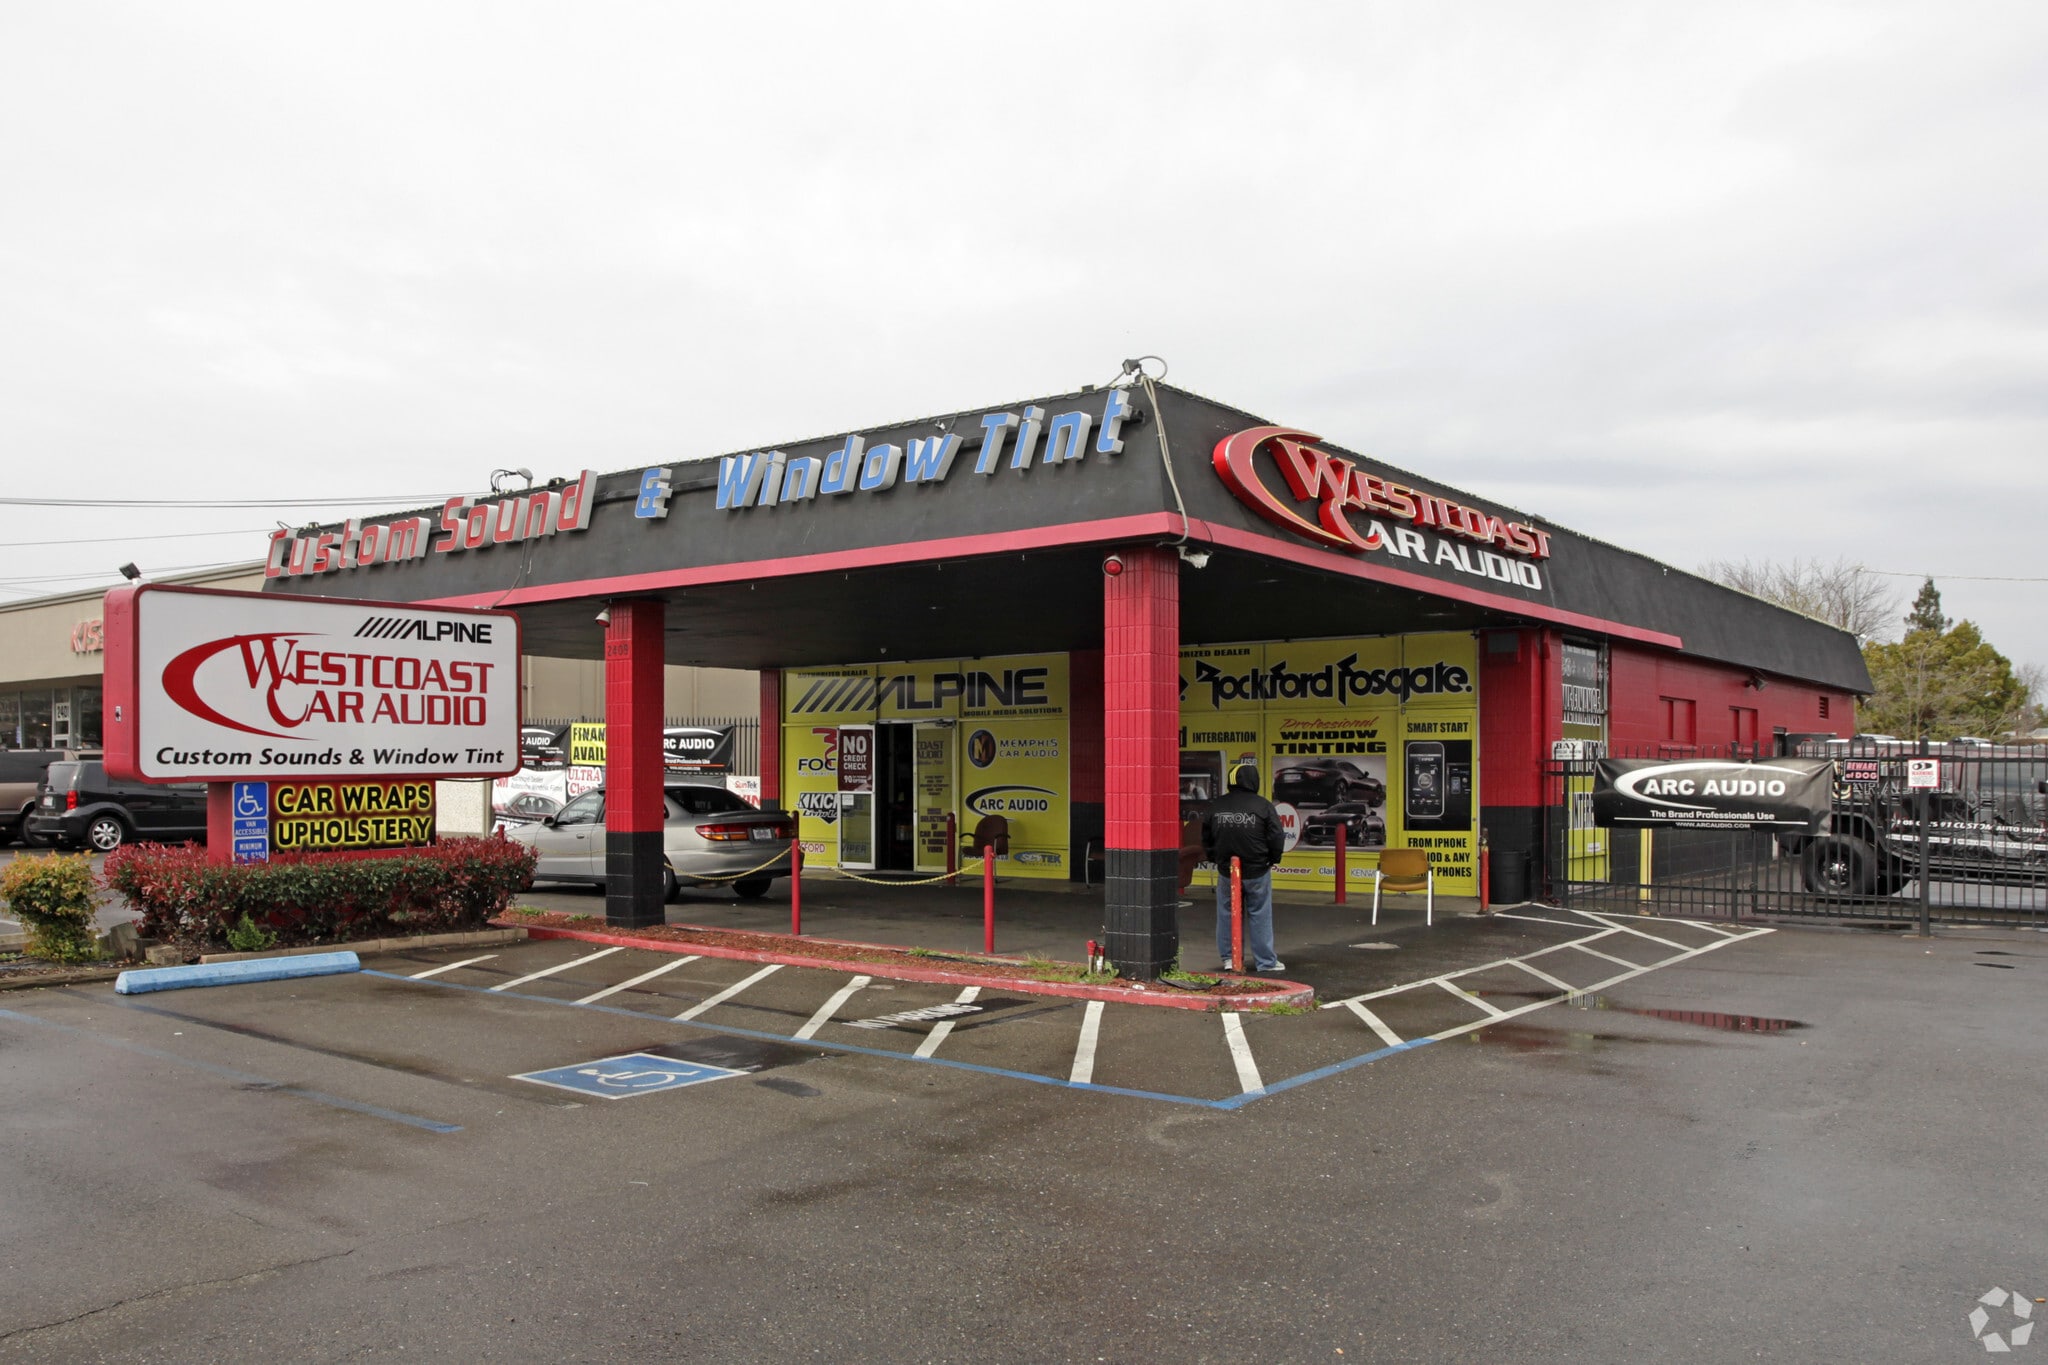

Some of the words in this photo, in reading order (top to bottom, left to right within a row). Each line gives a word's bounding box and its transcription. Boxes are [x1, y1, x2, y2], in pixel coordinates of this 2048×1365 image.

[264, 517, 431, 580] Custom
[435, 469, 598, 553] Sound
[634, 466, 673, 519] &
[716, 434, 964, 511] Window
[974, 388, 1133, 476] Tint
[1266, 437, 1551, 562] WESTCOAST
[1320, 498, 1430, 565] CAR
[1433, 542, 1543, 592] AUDIO
[71, 620, 104, 653] KIS
[400, 618, 492, 645] ALPINE
[1178, 650, 1211, 659] ORIZED
[1214, 648, 1250, 657] DEALER
[234, 634, 495, 694] WESTCOAST
[842, 669, 868, 679] DEALER
[866, 667, 1048, 711] ALPINE
[1196, 659, 1334, 710] Rockford
[266, 684, 365, 728] CAR
[371, 692, 487, 727] AUDIO
[963, 709, 991, 718] MOBILE
[993, 708, 1016, 717] MEDIA
[1018, 706, 1063, 716] SOLUTIONS
[1280, 716, 1380, 731] Professional
[1407, 722, 1438, 733] SMART
[1440, 721, 1469, 733] START
[573, 727, 606, 742] FINAN
[1192, 731, 1257, 743] INTERGRATION
[1280, 729, 1378, 741] WINDOW
[526, 736, 551, 746] AUDIO
[663, 738, 677, 749] RC
[679, 738, 715, 750] AUDIO
[843, 735, 867, 755] NO
[1000, 738, 1058, 748] MEMPHIS
[1555, 742, 1578, 750] BAY
[573, 746, 606, 761] AVAIL
[1024, 749, 1059, 757] AUDIO
[1271, 741, 1387, 755] TINTING
[156, 746, 252, 766] Custom
[260, 747, 342, 766] Sounds
[350, 748, 365, 764] &
[373, 747, 457, 765] Window
[466, 748, 505, 764] Tint
[843, 754, 867, 763] CREDIT
[798, 758, 837, 771] FOC
[843, 762, 867, 771] CHECK
[1846, 762, 1878, 771] BEWARE
[568, 768, 601, 782] ULTRA
[1855, 771, 1878, 780] DOG
[1642, 778, 1696, 796] ARC
[1701, 779, 1787, 797] AUDIO
[277, 786, 335, 813] CAR
[342, 784, 431, 812] WRAPS
[979, 798, 1004, 811] ARC
[1008, 798, 1048, 811] AUDIO
[1214, 811, 1256, 825] TRON
[1650, 810, 1665, 818] The
[1667, 810, 1694, 819] Brand
[1696, 811, 1753, 821] Professionals
[1756, 812, 1775, 821] Use
[235, 828, 267, 836] ACCESSIBLE
[277, 816, 431, 846] UPHOLSTERY
[1996, 824, 2020, 833] AUTO
[2021, 825, 2046, 835] SHOP
[1408, 837, 1432, 848] FROM
[1435, 837, 1467, 848] IPHONE
[1445, 853, 1451, 862] &
[1453, 852, 1470, 862] ANY
[1437, 866, 1472, 877] PHONES
[841, 1019, 899, 1029] NO
